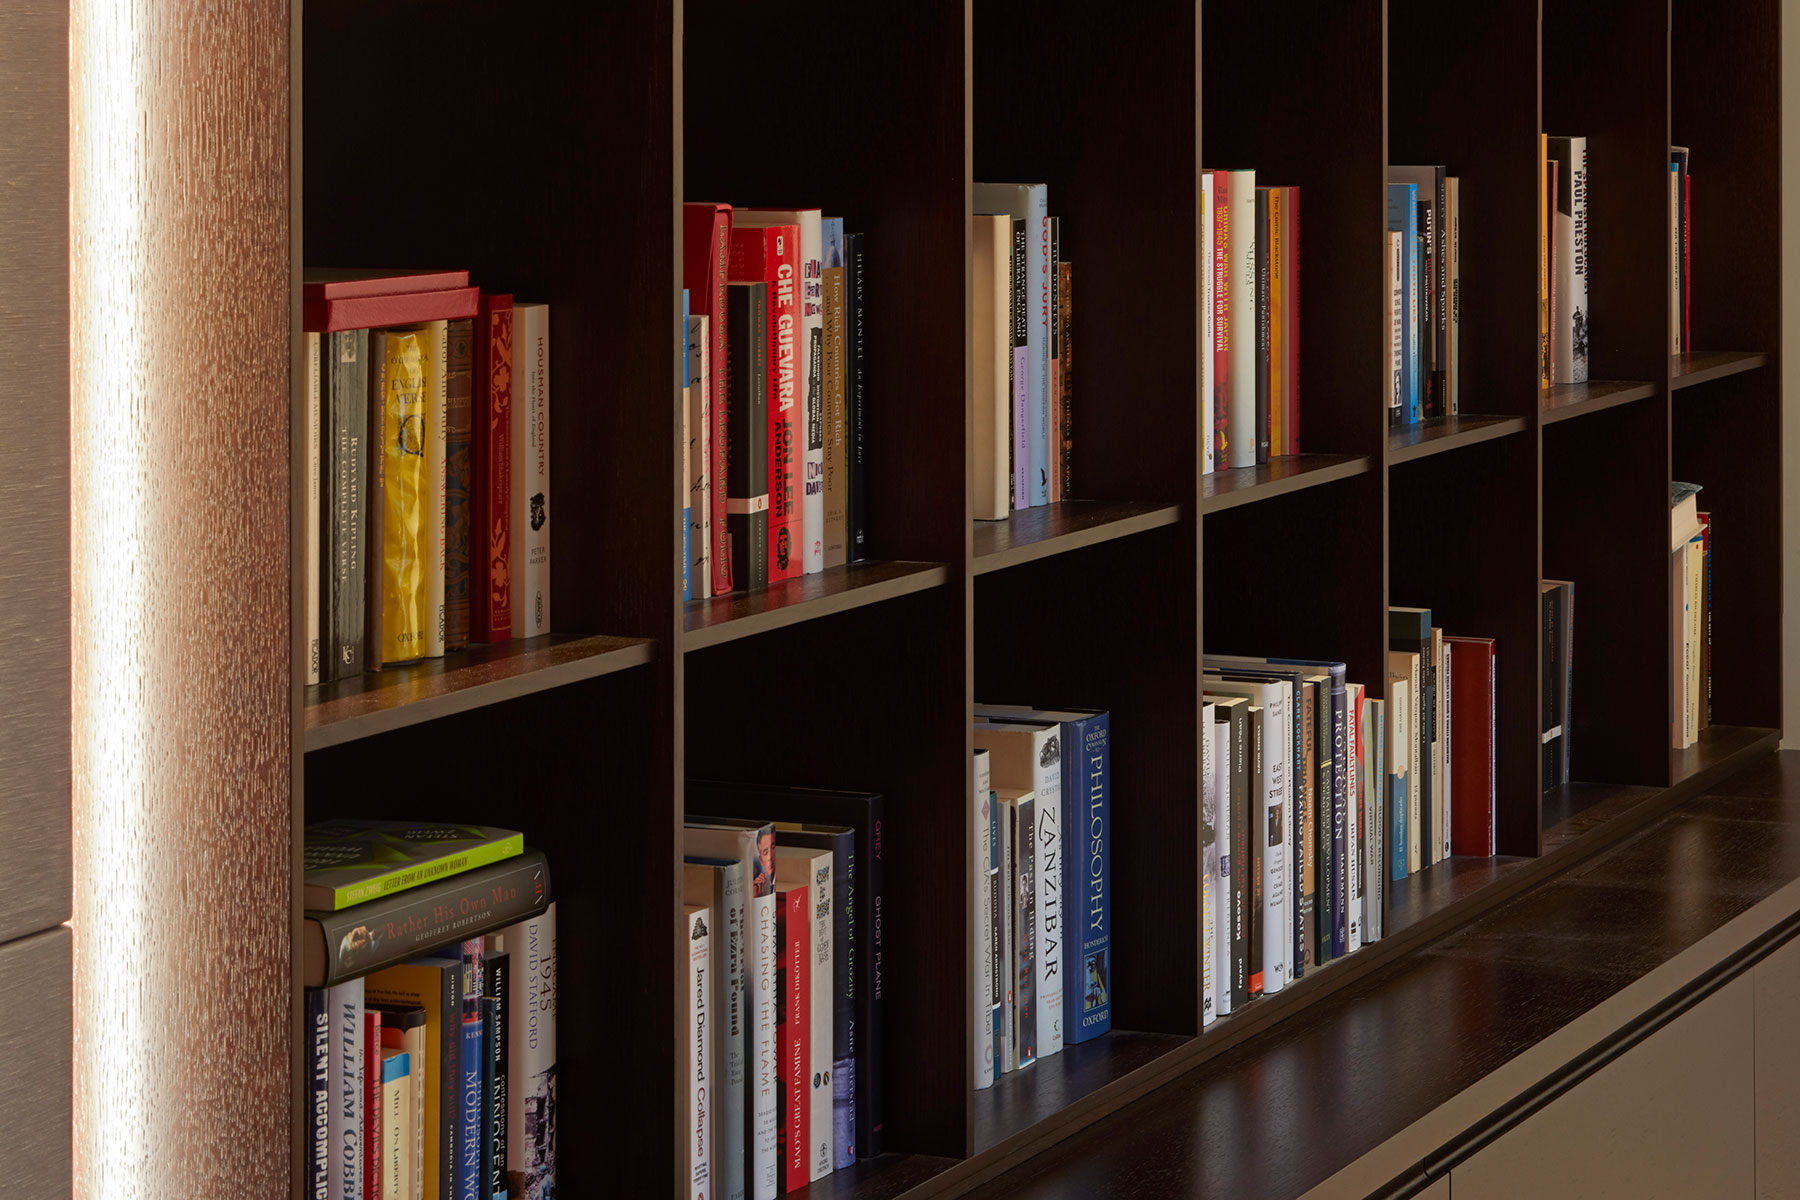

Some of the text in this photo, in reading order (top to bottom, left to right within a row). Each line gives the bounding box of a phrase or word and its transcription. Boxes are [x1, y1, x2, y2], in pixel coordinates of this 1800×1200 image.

[1216, 248, 1224, 261] THE
[1574, 171, 1584, 276] PAUL PRESTON
[1216, 264, 1224, 298] STRUGGLE
[1216, 300, 1224, 315] FOR
[777, 265, 794, 413] CHE GUEVARA
[825, 319, 833, 347] Why
[834, 275, 842, 446] How Rich Countries Got Rich
[1216, 316, 1224, 353] SURVIVAL
[537, 337, 545, 476] HOUSMAN COUNTRY
[719, 225, 729, 578] LAMPEDUSA THE LEOPARD FOLIO
[825, 438, 833, 463] Stay
[349, 437, 359, 570] RUDYARD KIPLING
[774, 422, 784, 517] ANDERSON
[783, 418, 793, 517] JON LEE
[1334, 710, 1343, 840] PROTECTION
[1090, 756, 1104, 930] PHILOSOPHY
[388, 886, 516, 940] Rather His Own Man
[416, 911, 491, 942] GEOFFREY ROBERTSON
[1039, 807, 1058, 982] ZANZIBAR
[494, 968, 502, 1061] WILLIAM SAMPSON
[528, 924, 538, 1050] DAVID STAFFORD
[540, 954, 552, 1011] 1945
[761, 906, 770, 1096] CHASING THE FLAME
[316, 1012, 328, 1082] SILENT
[343, 1004, 356, 1119] WILLIAM
[696, 968, 706, 1157] Jared Diamond Collapse
[466, 1071, 477, 1166] MODERN
